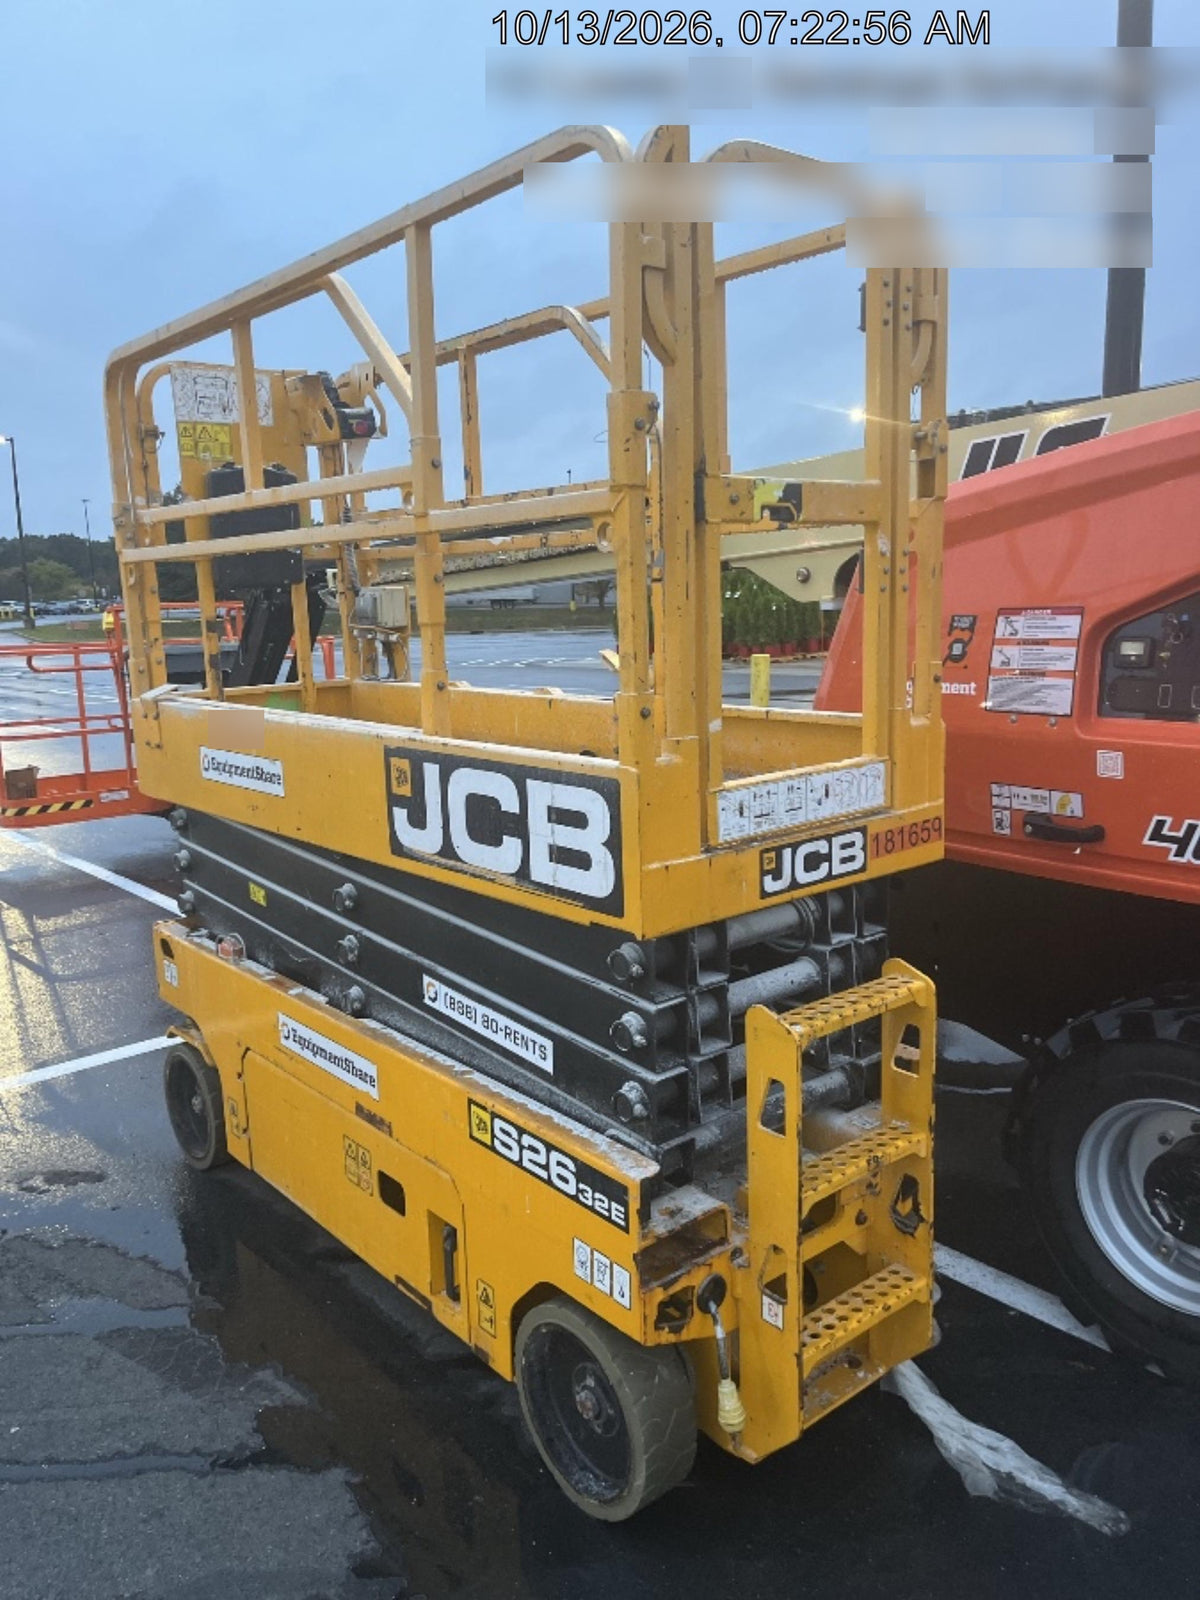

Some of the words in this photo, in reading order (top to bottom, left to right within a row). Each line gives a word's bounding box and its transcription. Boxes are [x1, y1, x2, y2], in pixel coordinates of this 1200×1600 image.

[392, 761, 616, 899] JCB
[872, 817, 943, 858] 181659
[762, 831, 865, 893] JCB
[481, 1012, 548, 1062] 80-RENTS
